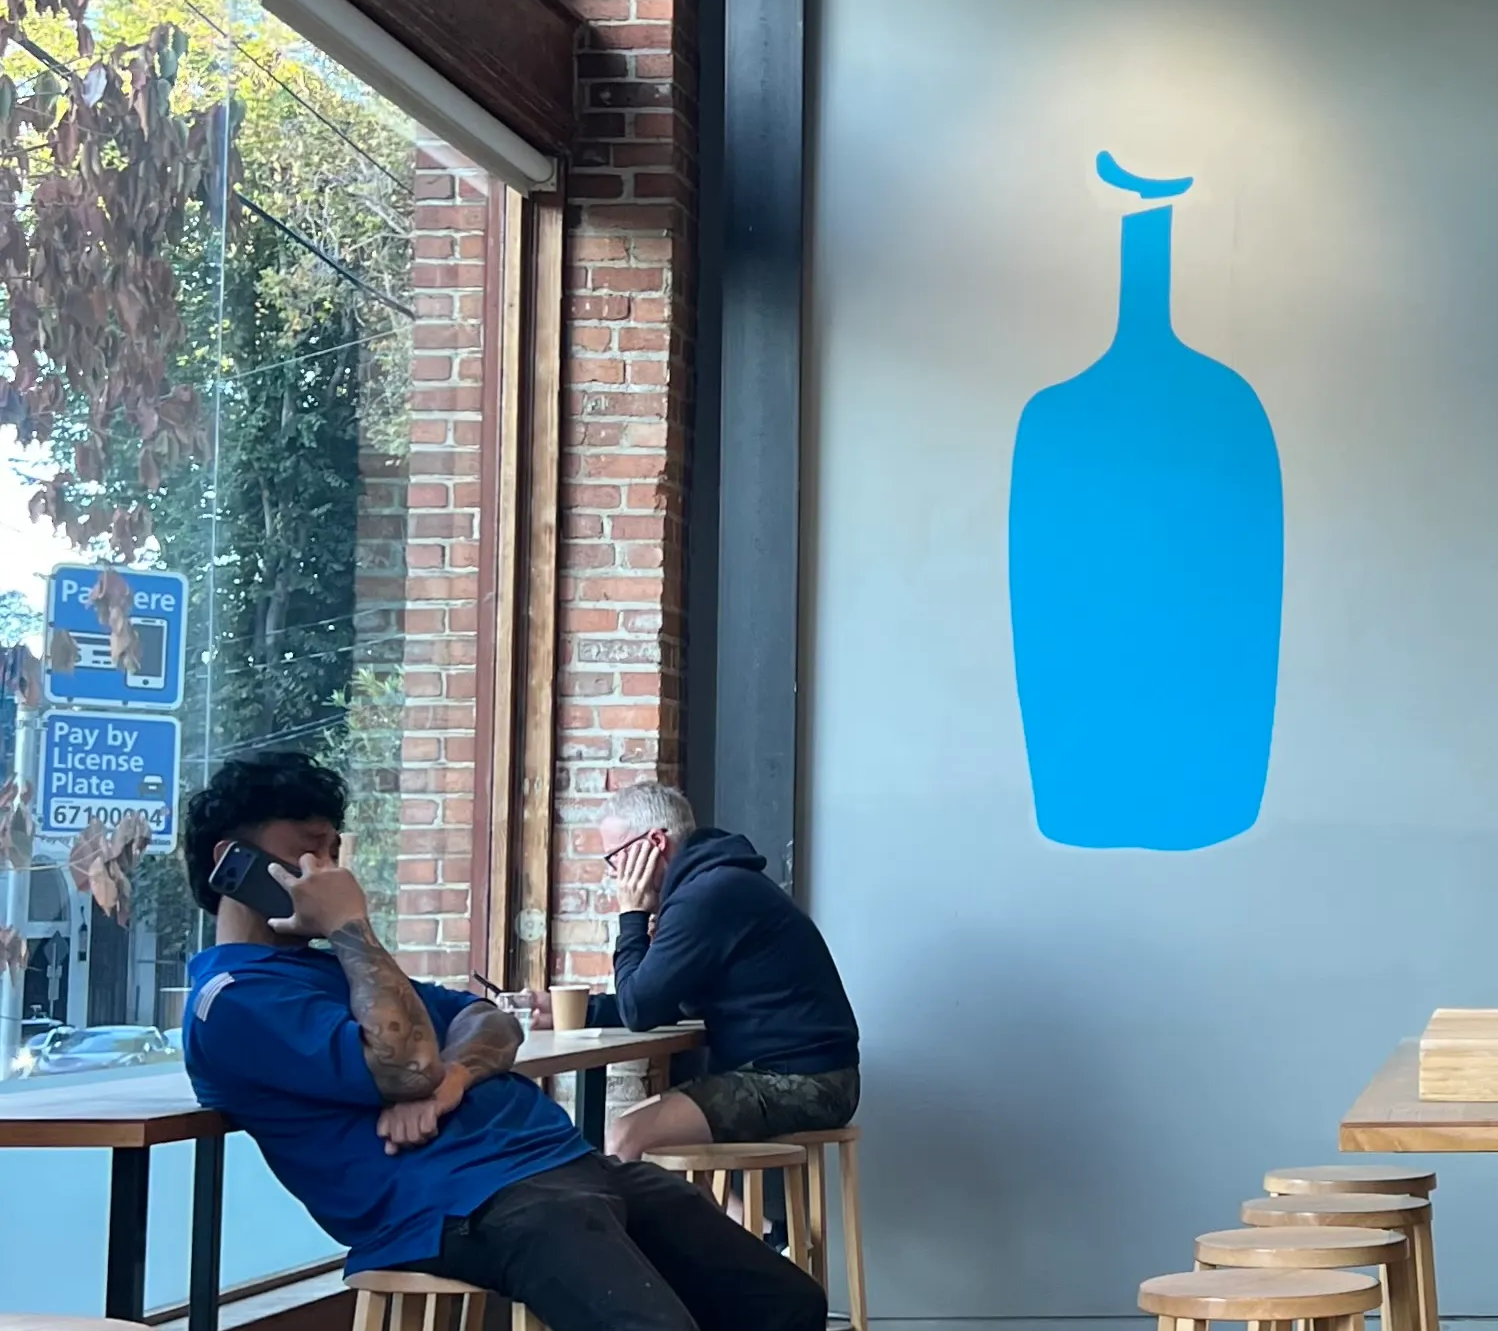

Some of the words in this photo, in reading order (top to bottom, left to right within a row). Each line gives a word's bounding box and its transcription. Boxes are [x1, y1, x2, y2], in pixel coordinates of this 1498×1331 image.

[62, 579, 93, 605] Pa
[133, 591, 176, 612] ere
[54, 721, 100, 751] Pay
[107, 723, 139, 753] by
[53, 746, 144, 773] License
[51, 771, 115, 796] Plate
